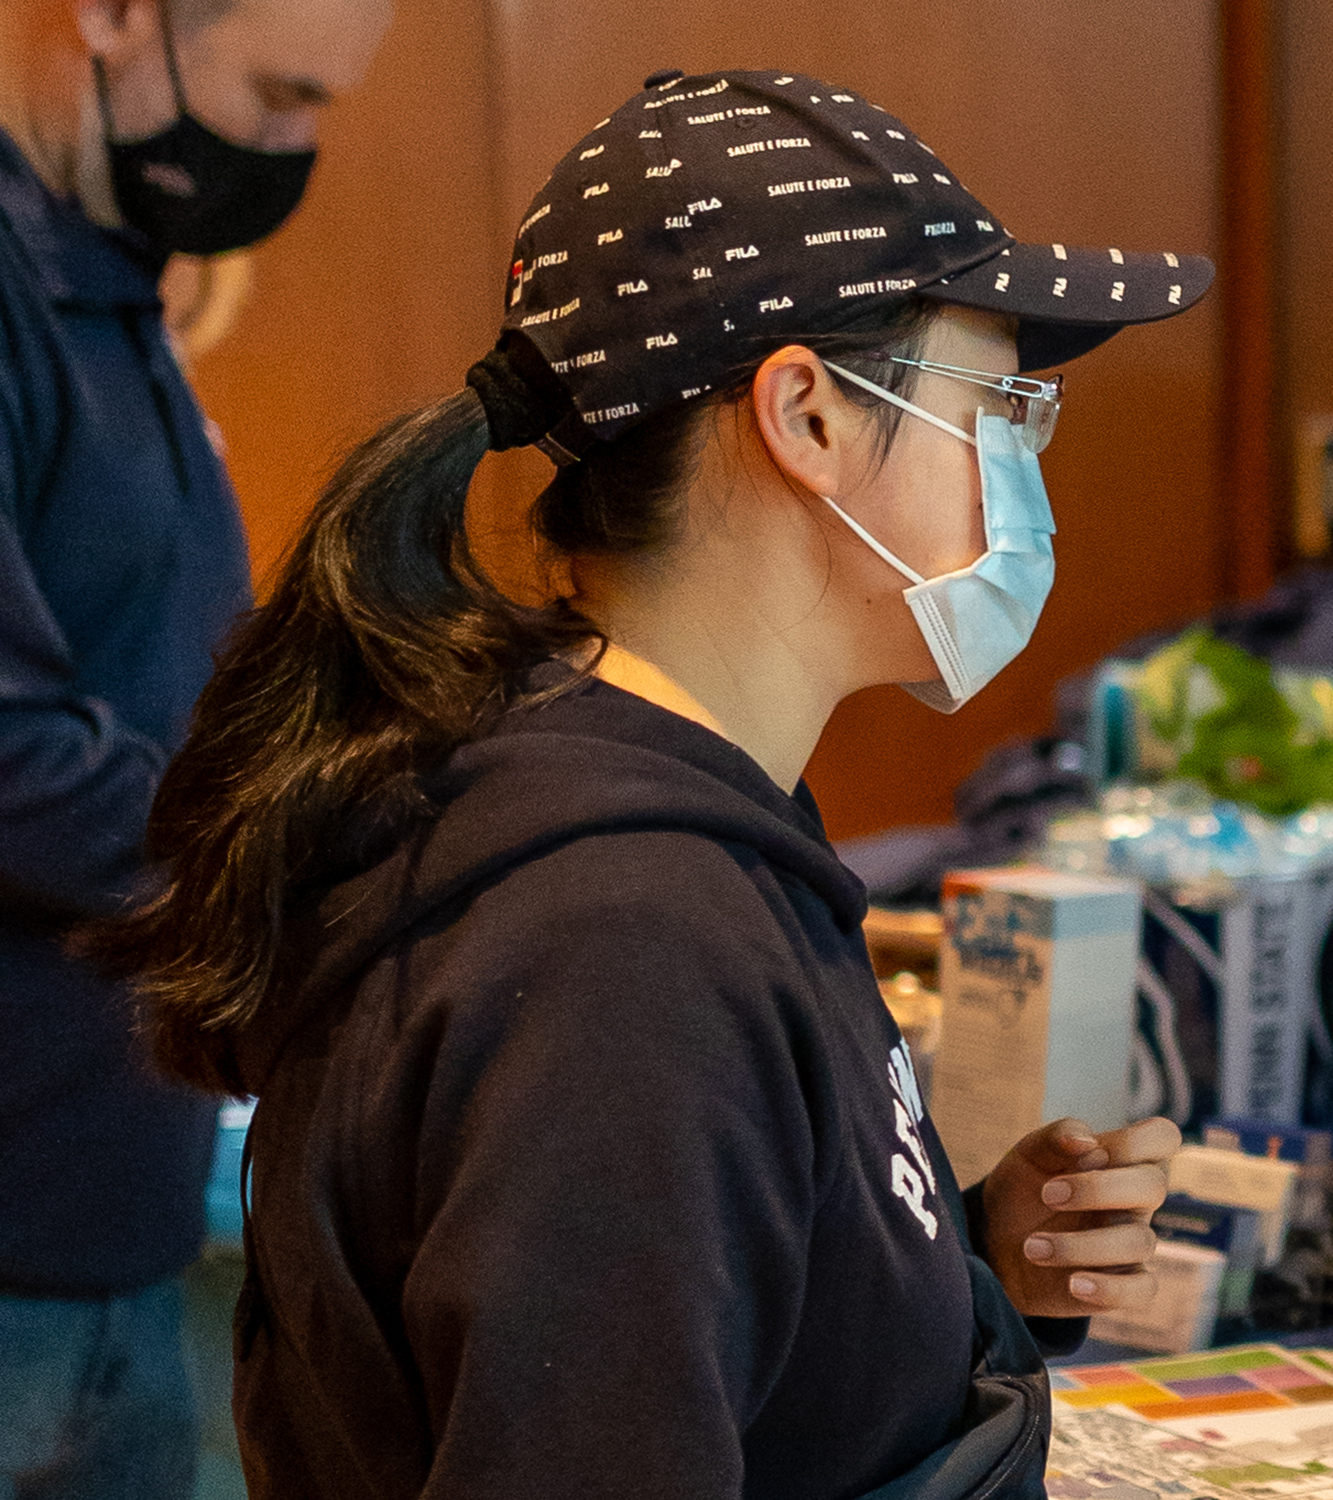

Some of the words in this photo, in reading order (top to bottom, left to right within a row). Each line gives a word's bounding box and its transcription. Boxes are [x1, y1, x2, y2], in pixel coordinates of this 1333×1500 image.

[687, 112, 725, 125] SALUTE
[726, 110, 733, 118] E
[735, 105, 771, 116] FORZA
[727, 142, 765, 157] SALUTE
[766, 140, 774, 150] E
[775, 137, 811, 149] FORZA
[582, 181, 610, 199] FILA
[767, 181, 805, 196] SALUTE
[807, 181, 814, 191] E
[816, 176, 851, 191] FORZA
[687, 196, 722, 215] FILA
[597, 228, 624, 246] FILA
[805, 231, 842, 247] SALUTE
[844, 230, 850, 241] E
[852, 227, 887, 241] FORZA
[537, 250, 568, 268] FORZA
[724, 244, 760, 262] FILA
[617, 279, 649, 297] FILA
[838, 282, 876, 298] SALUTE
[878, 280, 884, 292] E
[759, 295, 794, 313] FILA
[646, 331, 678, 350] FILA
[576, 350, 606, 369] FORZA
[606, 402, 640, 420] FORZA
